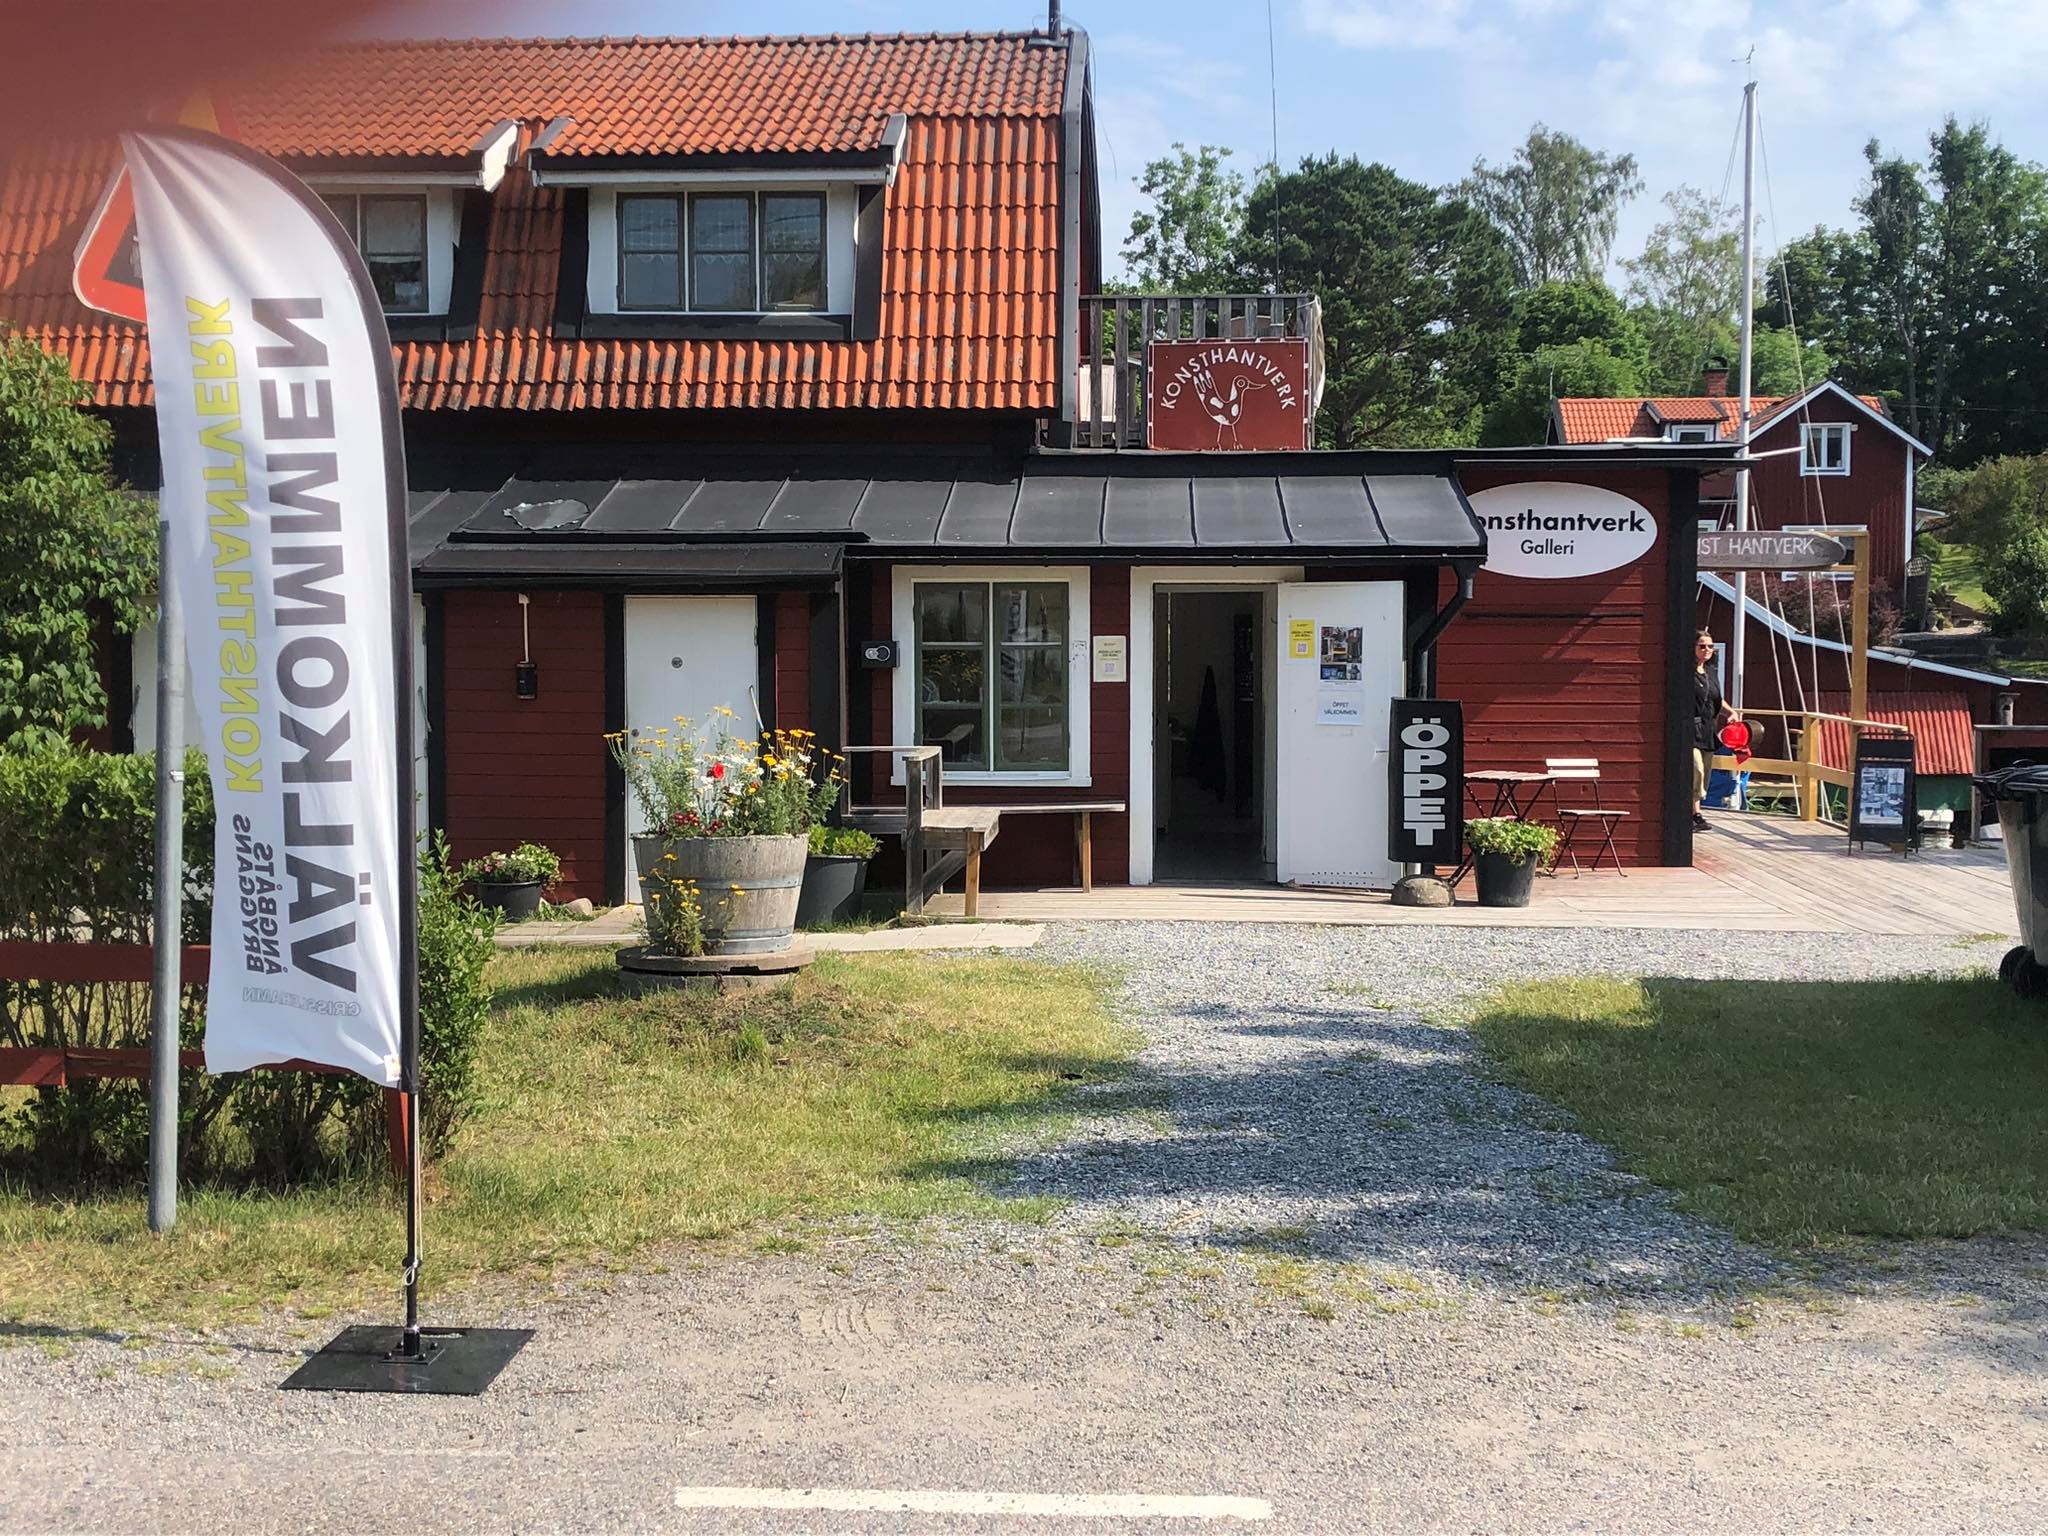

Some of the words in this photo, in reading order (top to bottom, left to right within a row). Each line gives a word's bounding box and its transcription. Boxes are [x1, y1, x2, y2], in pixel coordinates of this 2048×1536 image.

[1160, 347, 1297, 410] KONSTHANTVERK
[1476, 508, 1646, 532] onsthantverk
[1520, 538, 1575, 555] Galleri
[1729, 537, 1815, 556] HANTVERK
[1400, 717, 1450, 846] ÖPPET
